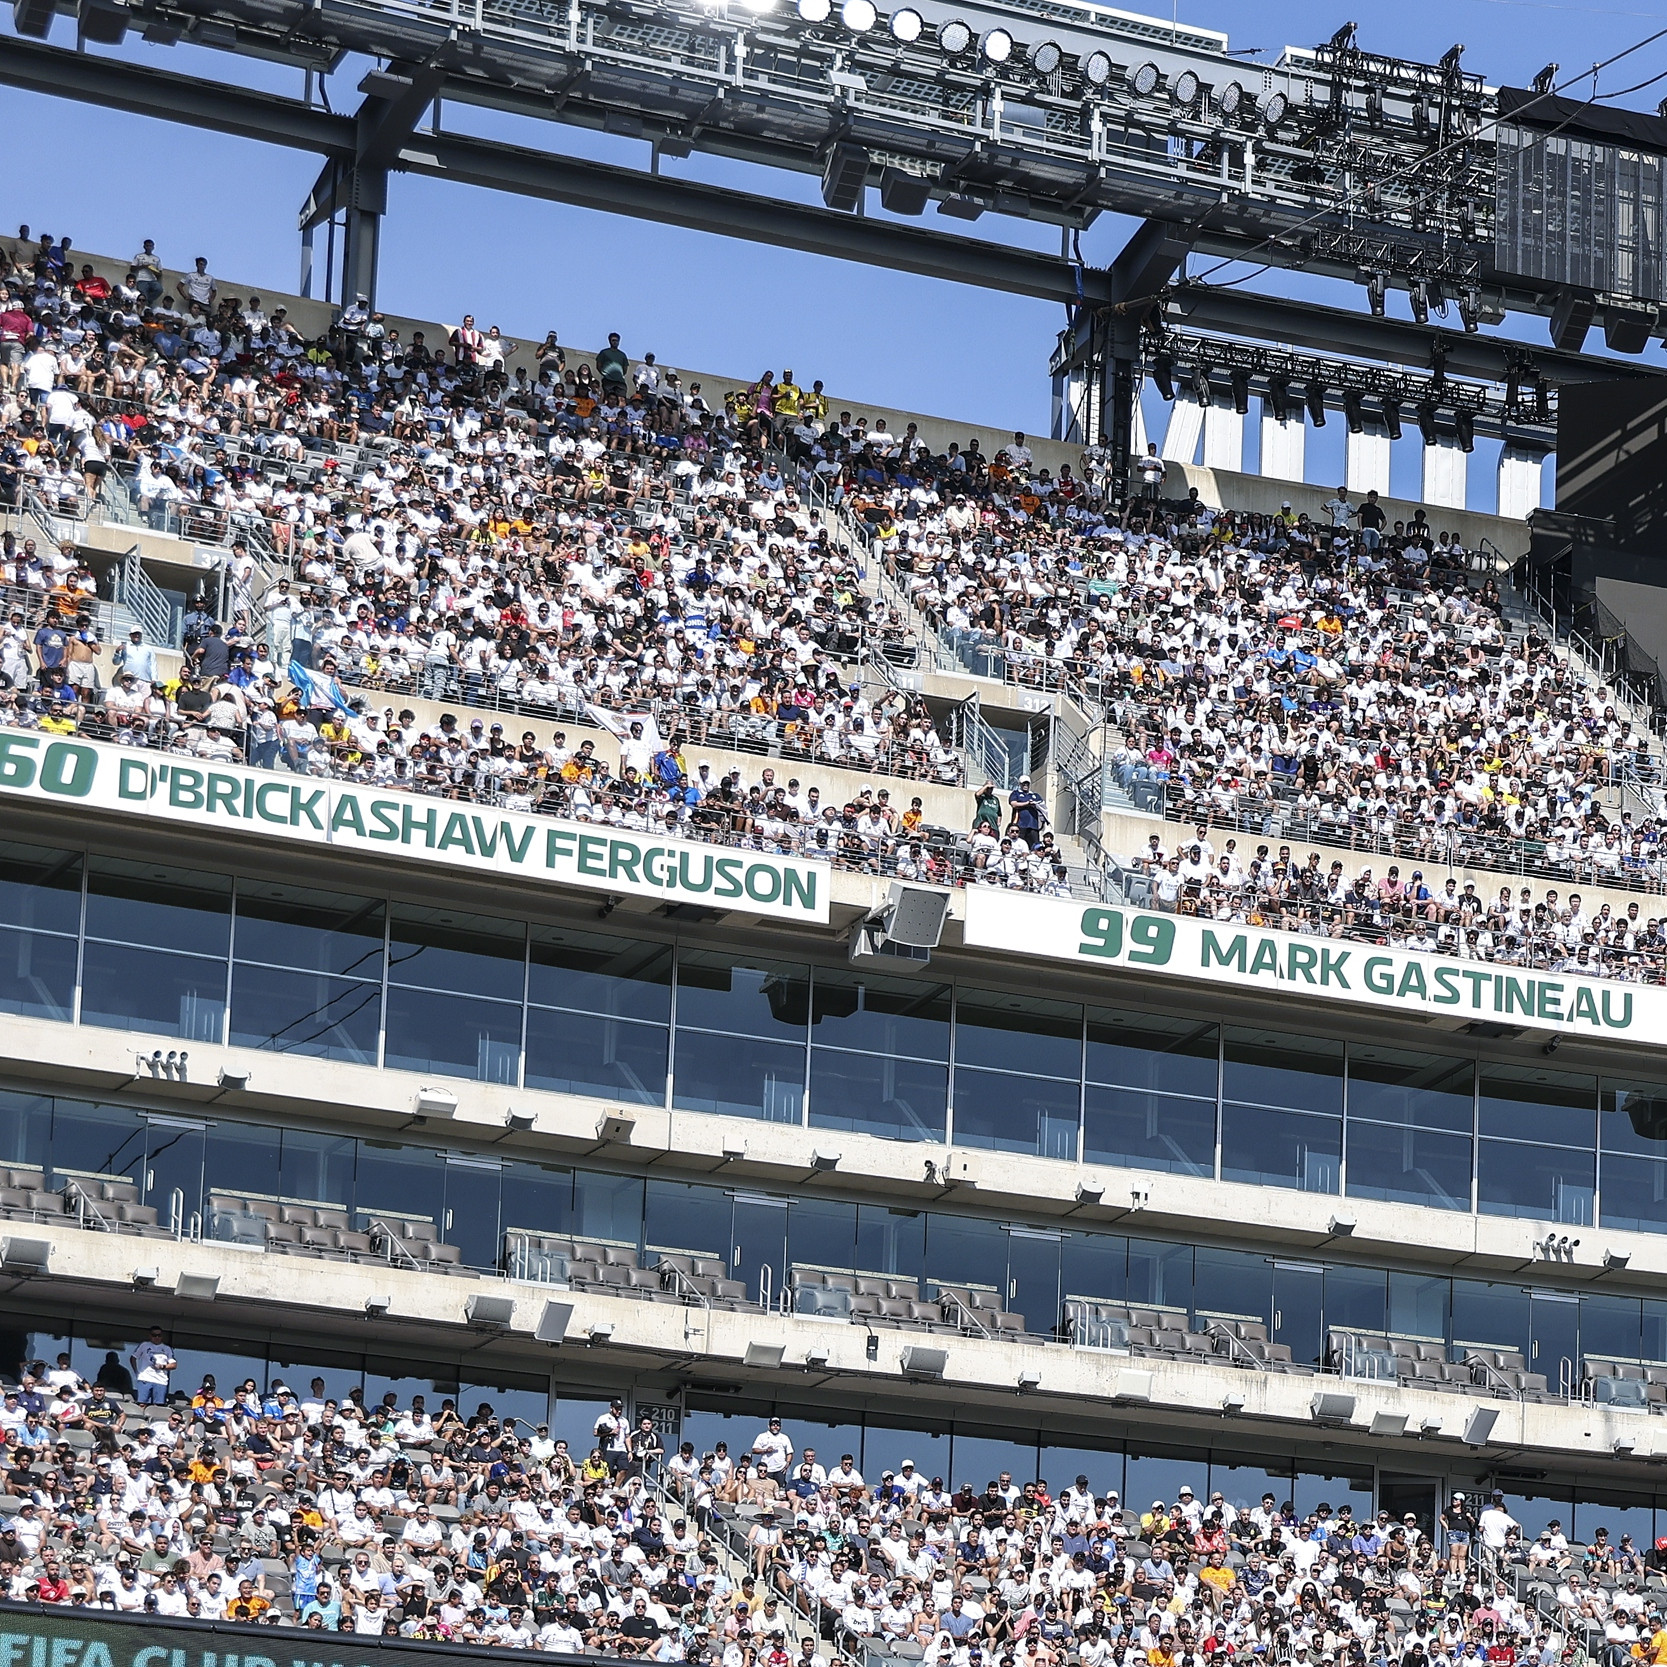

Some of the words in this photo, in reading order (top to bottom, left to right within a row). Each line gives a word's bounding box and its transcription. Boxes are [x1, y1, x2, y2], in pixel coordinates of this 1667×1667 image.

[118, 758, 534, 862] D'BRICKASHAW
[547, 829, 817, 910] FERGUSON
[1079, 908, 1176, 965] 99
[1201, 930, 1351, 989] MARK
[1363, 957, 1633, 1028] GASTINEAU
[652, 1408, 675, 1420] 210
